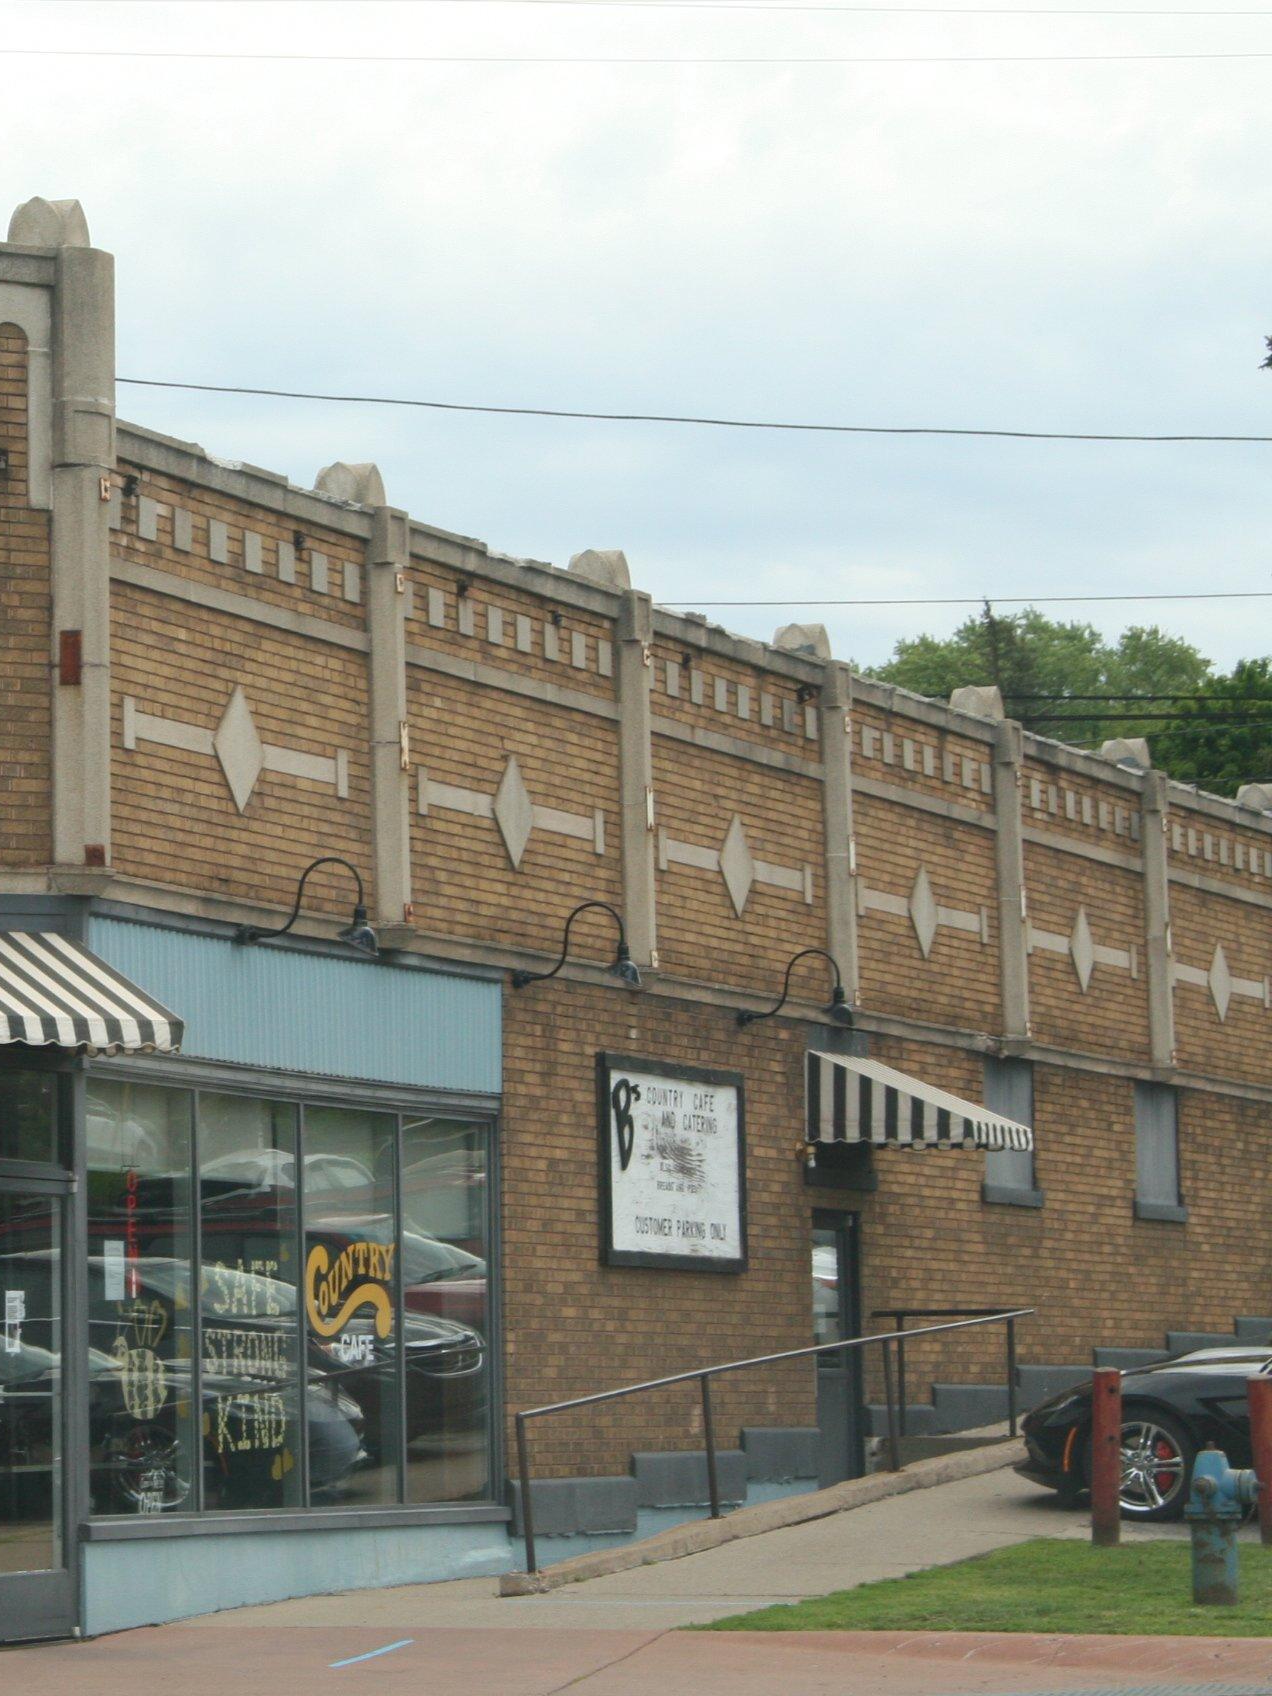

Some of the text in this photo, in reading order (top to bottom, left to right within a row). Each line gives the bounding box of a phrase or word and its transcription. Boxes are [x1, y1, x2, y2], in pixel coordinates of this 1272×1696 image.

[612, 1078, 642, 1171] B's
[646, 1086, 684, 1109] COUNTRY
[693, 1092, 715, 1113] CAFE
[661, 1110, 676, 1130] AND
[683, 1113, 718, 1135] CATERING
[635, 1215, 727, 1241] CUSTOMER PARKING ONLY
[213, 1258, 280, 1316] SAFE
[306, 1242, 396, 1340] COUNTRY
[205, 1328, 290, 1379] STRONG
[340, 1333, 375, 1361] CAFE
[218, 1393, 286, 1454] KIND
